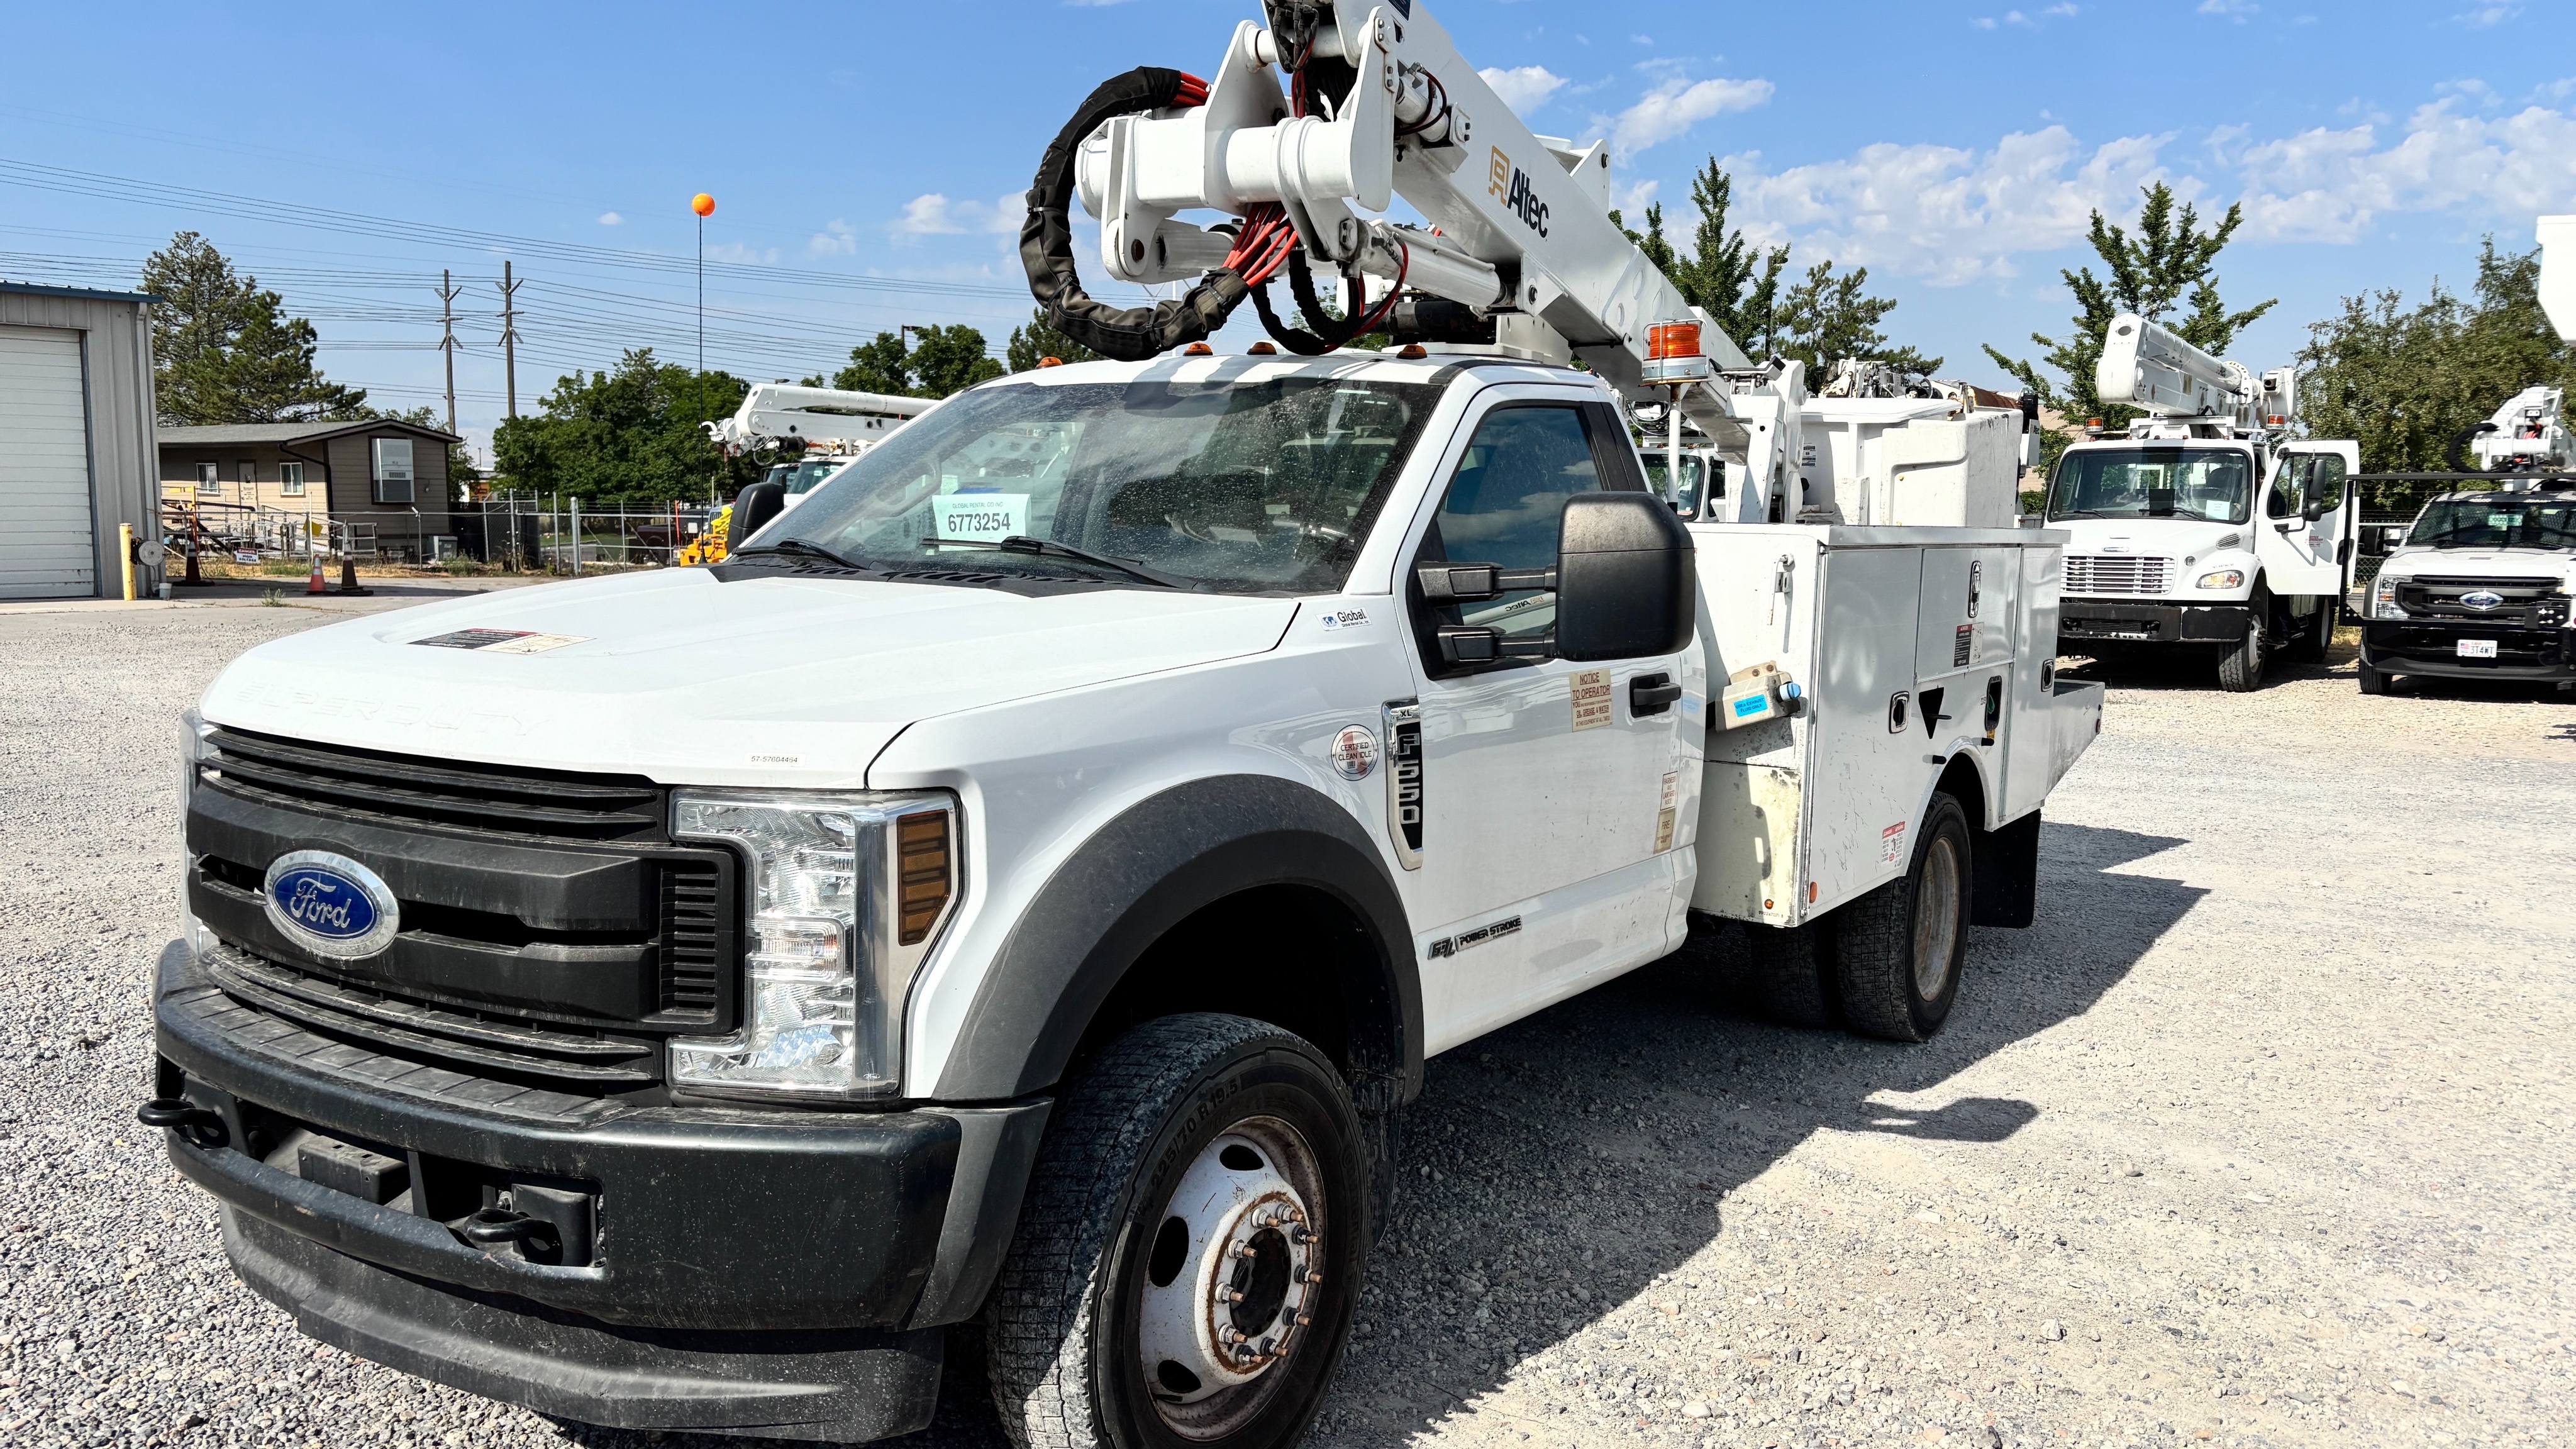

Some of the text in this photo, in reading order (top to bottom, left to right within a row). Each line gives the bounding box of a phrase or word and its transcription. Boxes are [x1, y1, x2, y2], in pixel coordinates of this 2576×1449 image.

[1507, 167, 1549, 238] Altec
[948, 513, 1011, 533] 6773254
[1337, 609, 1366, 623] Global
[1579, 672, 1600, 684] NOTICE
[1572, 684, 1611, 699] TO OPERATOR
[233, 680, 552, 736] SUPER DUTY
[1400, 709, 1412, 718] XL
[1340, 742, 1369, 751] CERTIFIED
[1338, 750, 1372, 761] CLEAN IDLE
[1397, 733, 1420, 824] F550
[1661, 819, 1670, 830] FIRE
[290, 877, 351, 929] Ford
[1459, 918, 1522, 946] POWER STROKE
[1150, 1117, 1197, 1191] 225/70
[1197, 1102, 1210, 1121] R
[1210, 1079, 1238, 1109] 19.5
